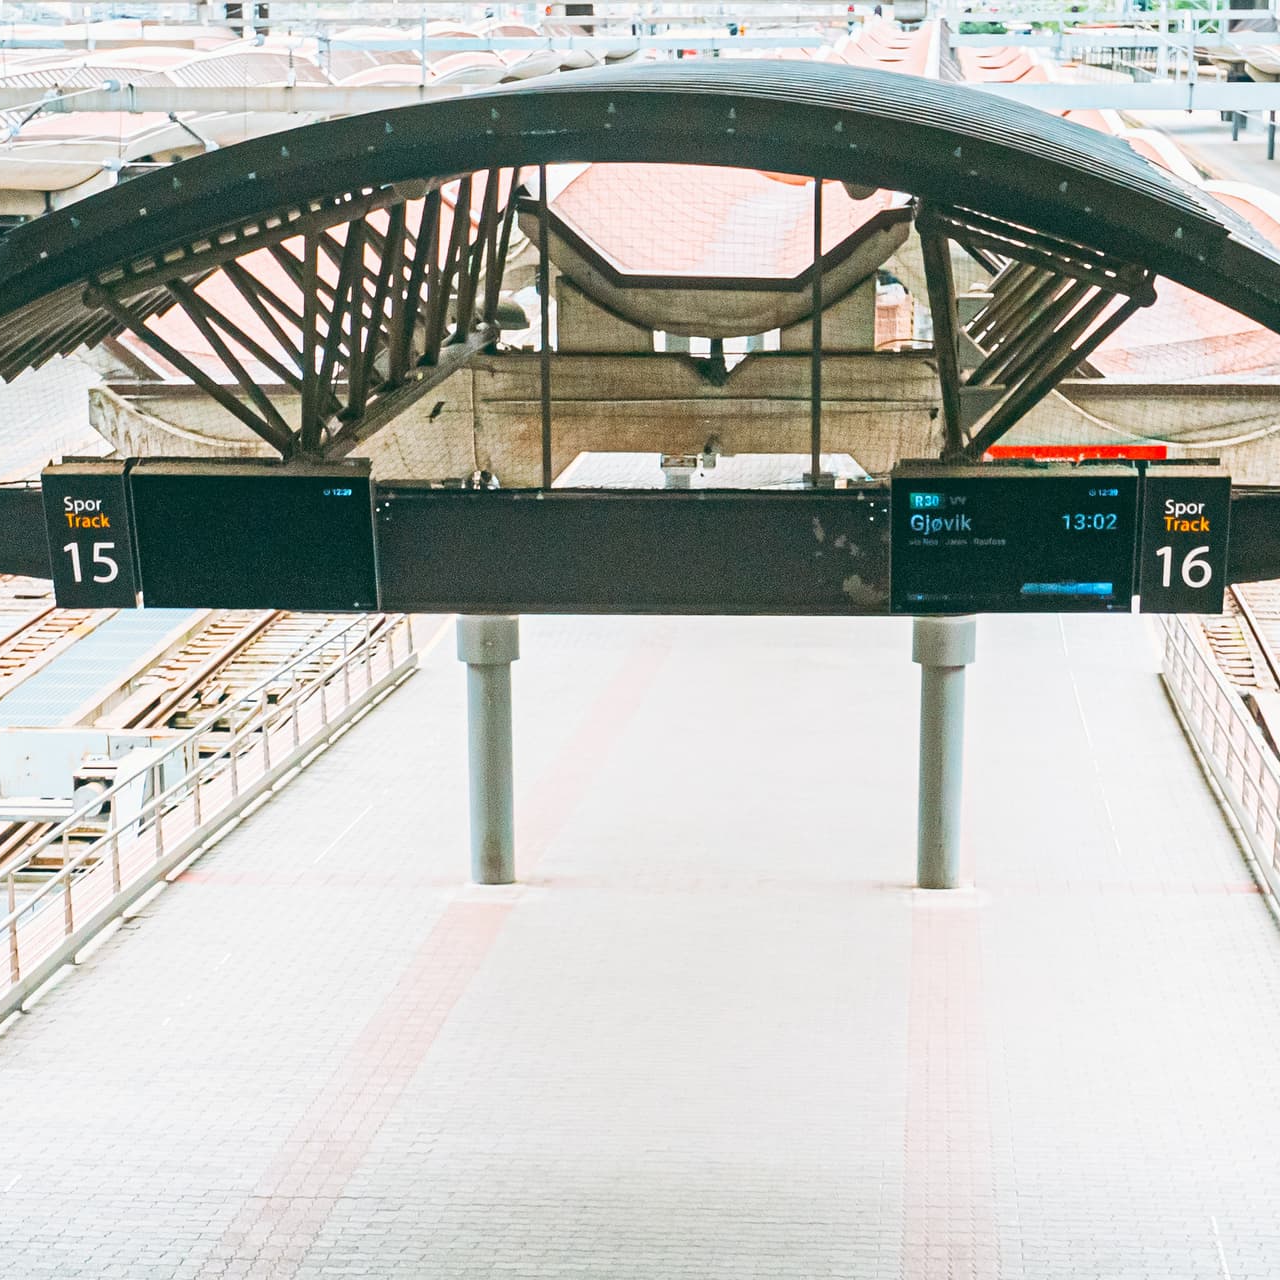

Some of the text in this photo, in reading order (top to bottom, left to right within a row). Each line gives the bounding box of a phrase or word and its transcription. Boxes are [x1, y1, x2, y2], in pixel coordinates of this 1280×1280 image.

[63, 496, 102, 513] Spor
[914, 495, 939, 507] R30
[1164, 499, 1205, 516] Spor
[64, 513, 110, 528] Track
[910, 514, 972, 535] Gjøvik
[1062, 513, 1118, 530] 13:02
[1164, 515, 1210, 532] Track
[63, 541, 119, 583] 15
[1156, 545, 1212, 589] 16
